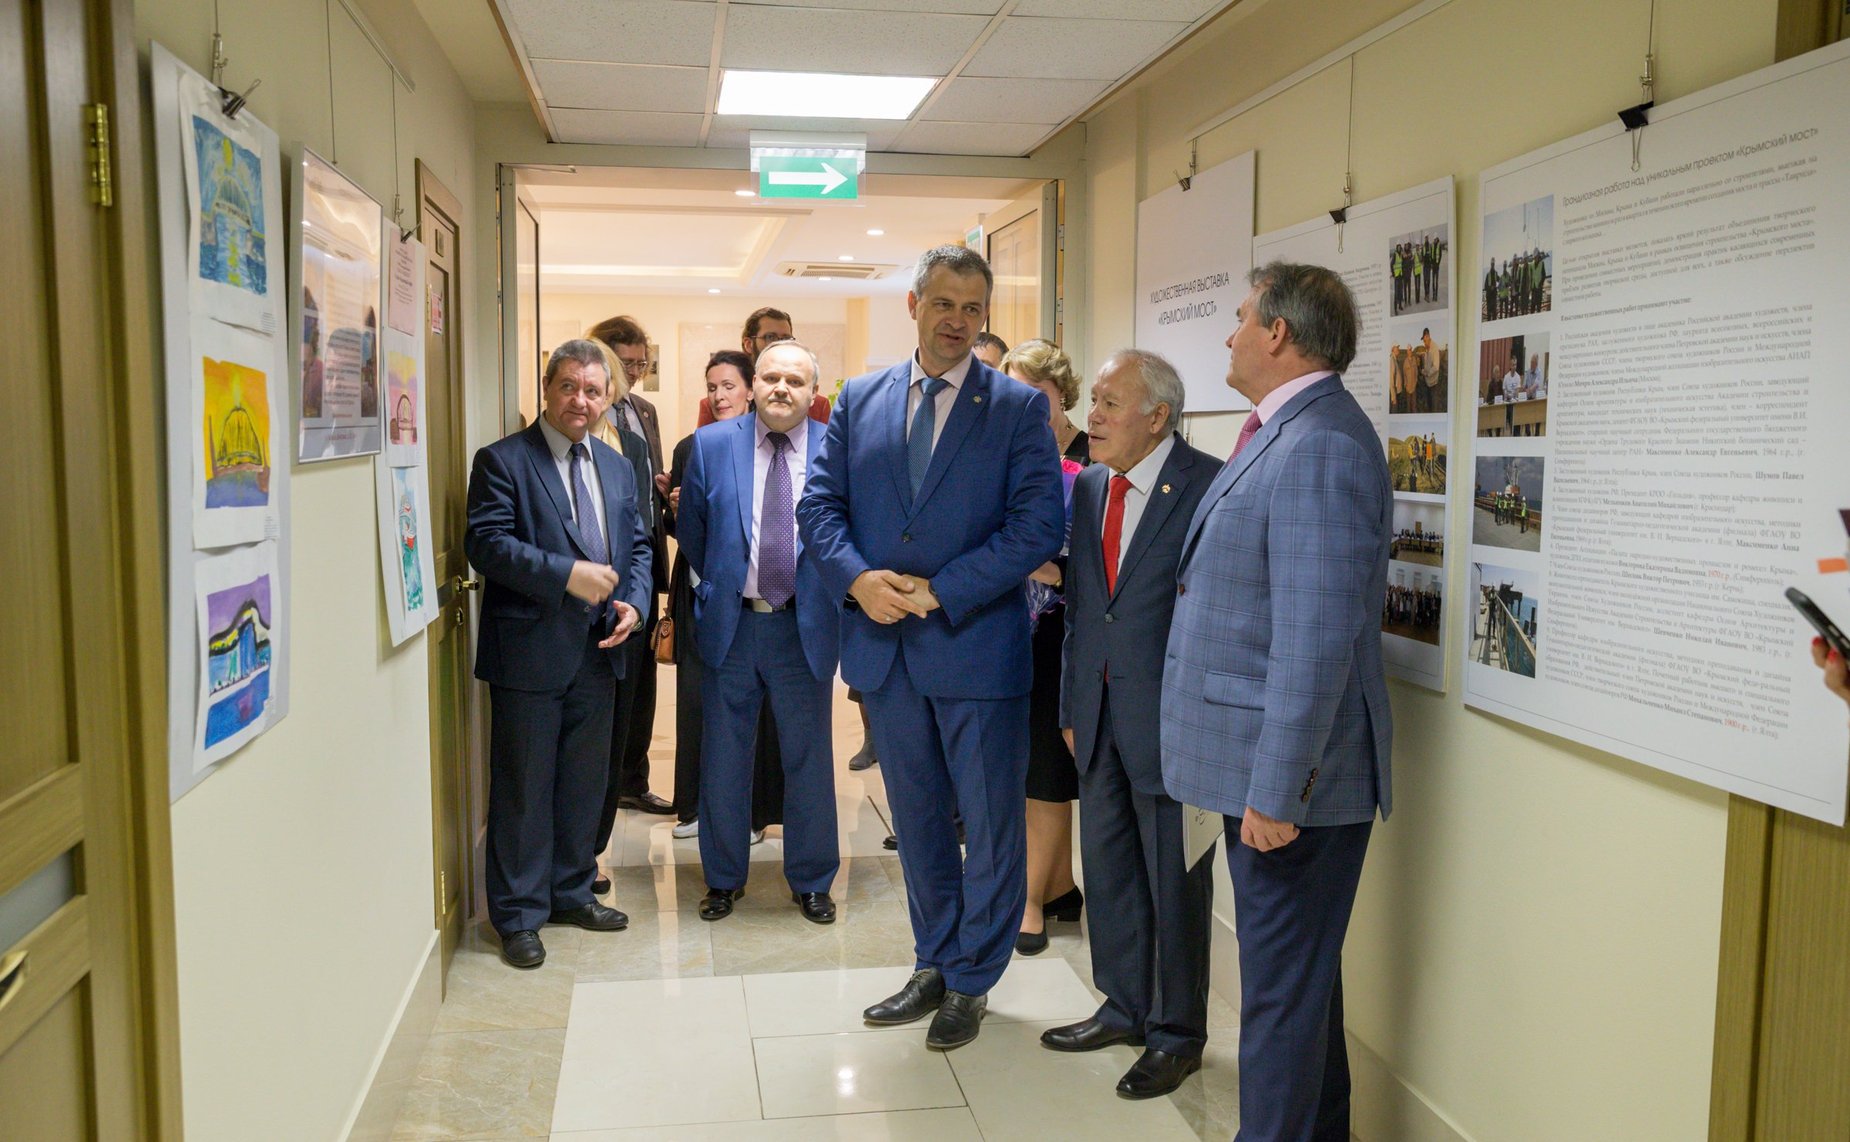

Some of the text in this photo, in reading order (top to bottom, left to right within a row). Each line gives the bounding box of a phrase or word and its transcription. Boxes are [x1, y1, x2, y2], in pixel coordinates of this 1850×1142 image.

[1562, 127, 1818, 207] Грандиозная работа над уникальным проектом «Крымский мост»
[1150, 272, 1230, 304] ХУДОЖЕСТВЕННАЯ ВЫСТАВКА
[1158, 300, 1217, 325] «КРЫМСКИЙ МОСТ»
